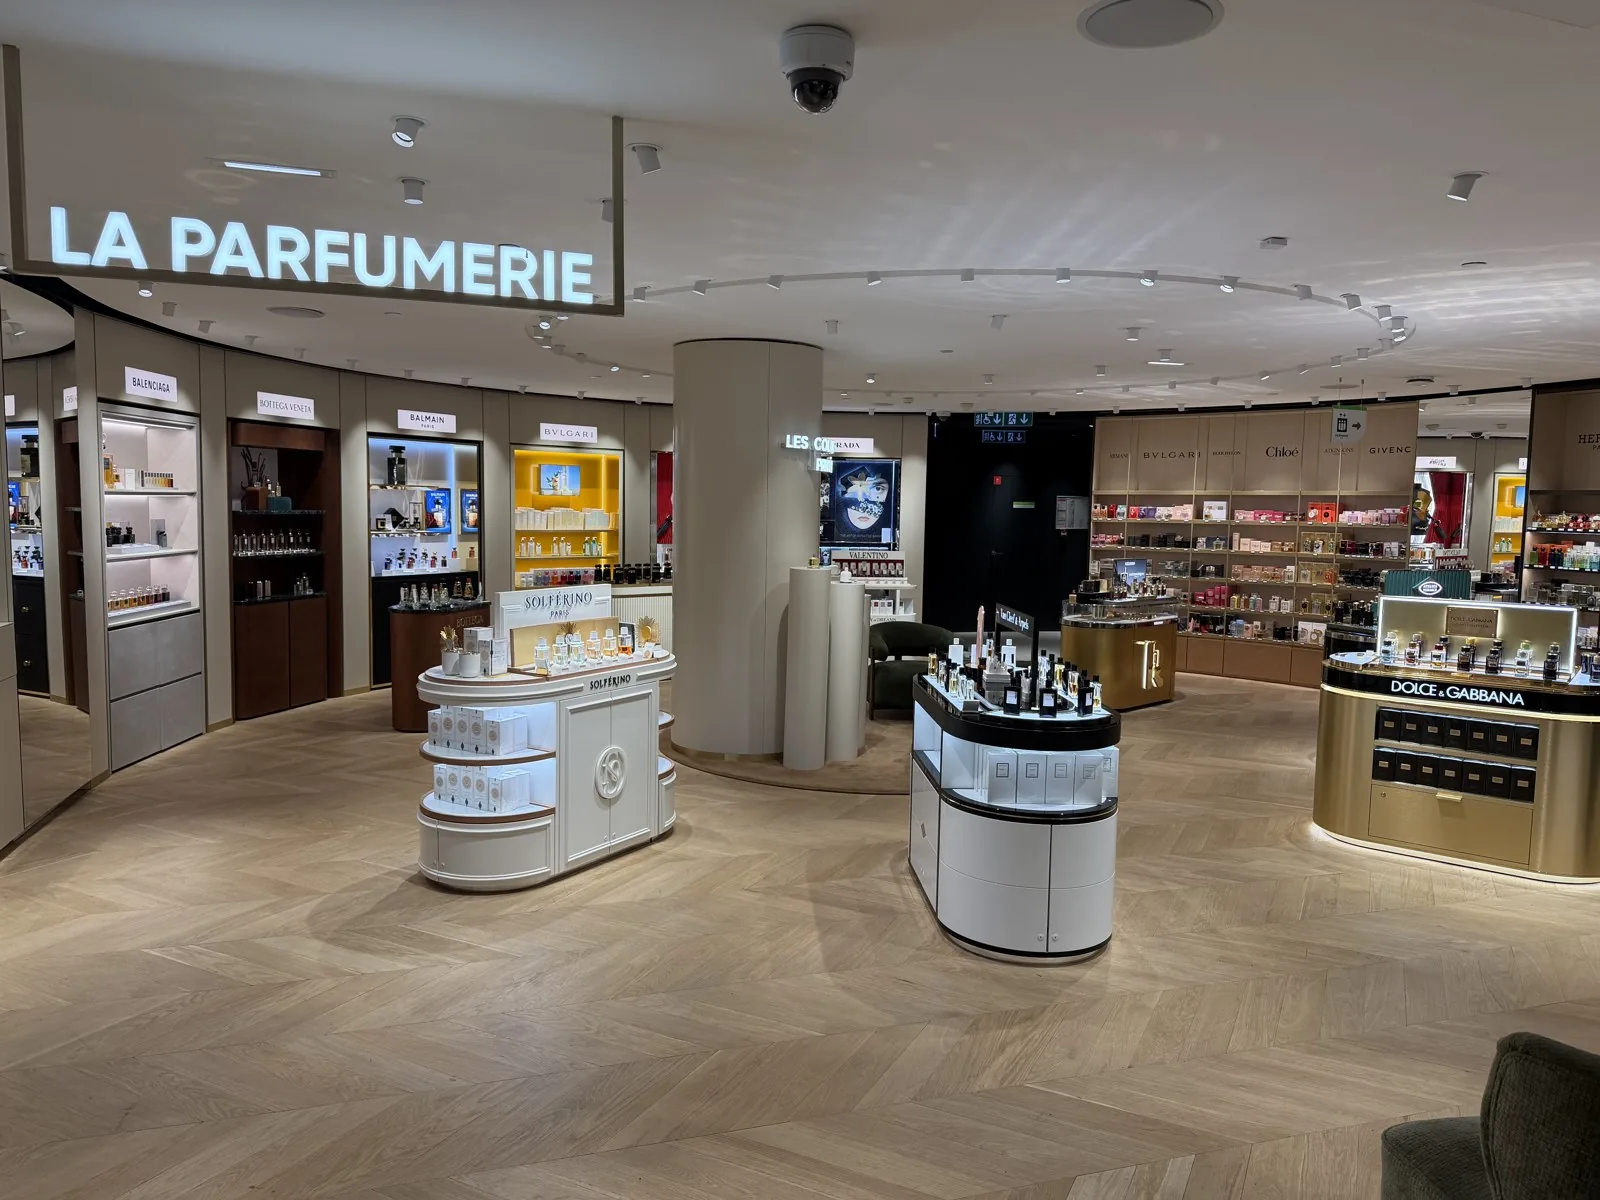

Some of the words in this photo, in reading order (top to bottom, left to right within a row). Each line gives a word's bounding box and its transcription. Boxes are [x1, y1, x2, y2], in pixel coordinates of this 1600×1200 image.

[50, 206, 148, 270] LA
[171, 216, 593, 304] PARFUMERIE
[132, 377, 170, 393] BALENCIAGA
[259, 398, 288, 411] BOTTEGA
[289, 402, 312, 414] VENETA
[410, 413, 445, 424] BALMAIN
[544, 428, 594, 438] BVLGARI
[786, 434, 808, 450] LES
[1143, 451, 1201, 459] BVLGARI
[1265, 445, 1299, 458] Chloé
[1369, 446, 1412, 454] GIVENC
[849, 551, 888, 559] VALENTINO
[525, 591, 593, 609] SOLFÉRINO
[456, 614, 484, 628] BOTTEGA
[550, 610, 569, 618] PARIS
[590, 674, 631, 690] SOLFÉRINO
[1391, 680, 1437, 696] DOLCE
[1446, 686, 1525, 706] GABBANA
